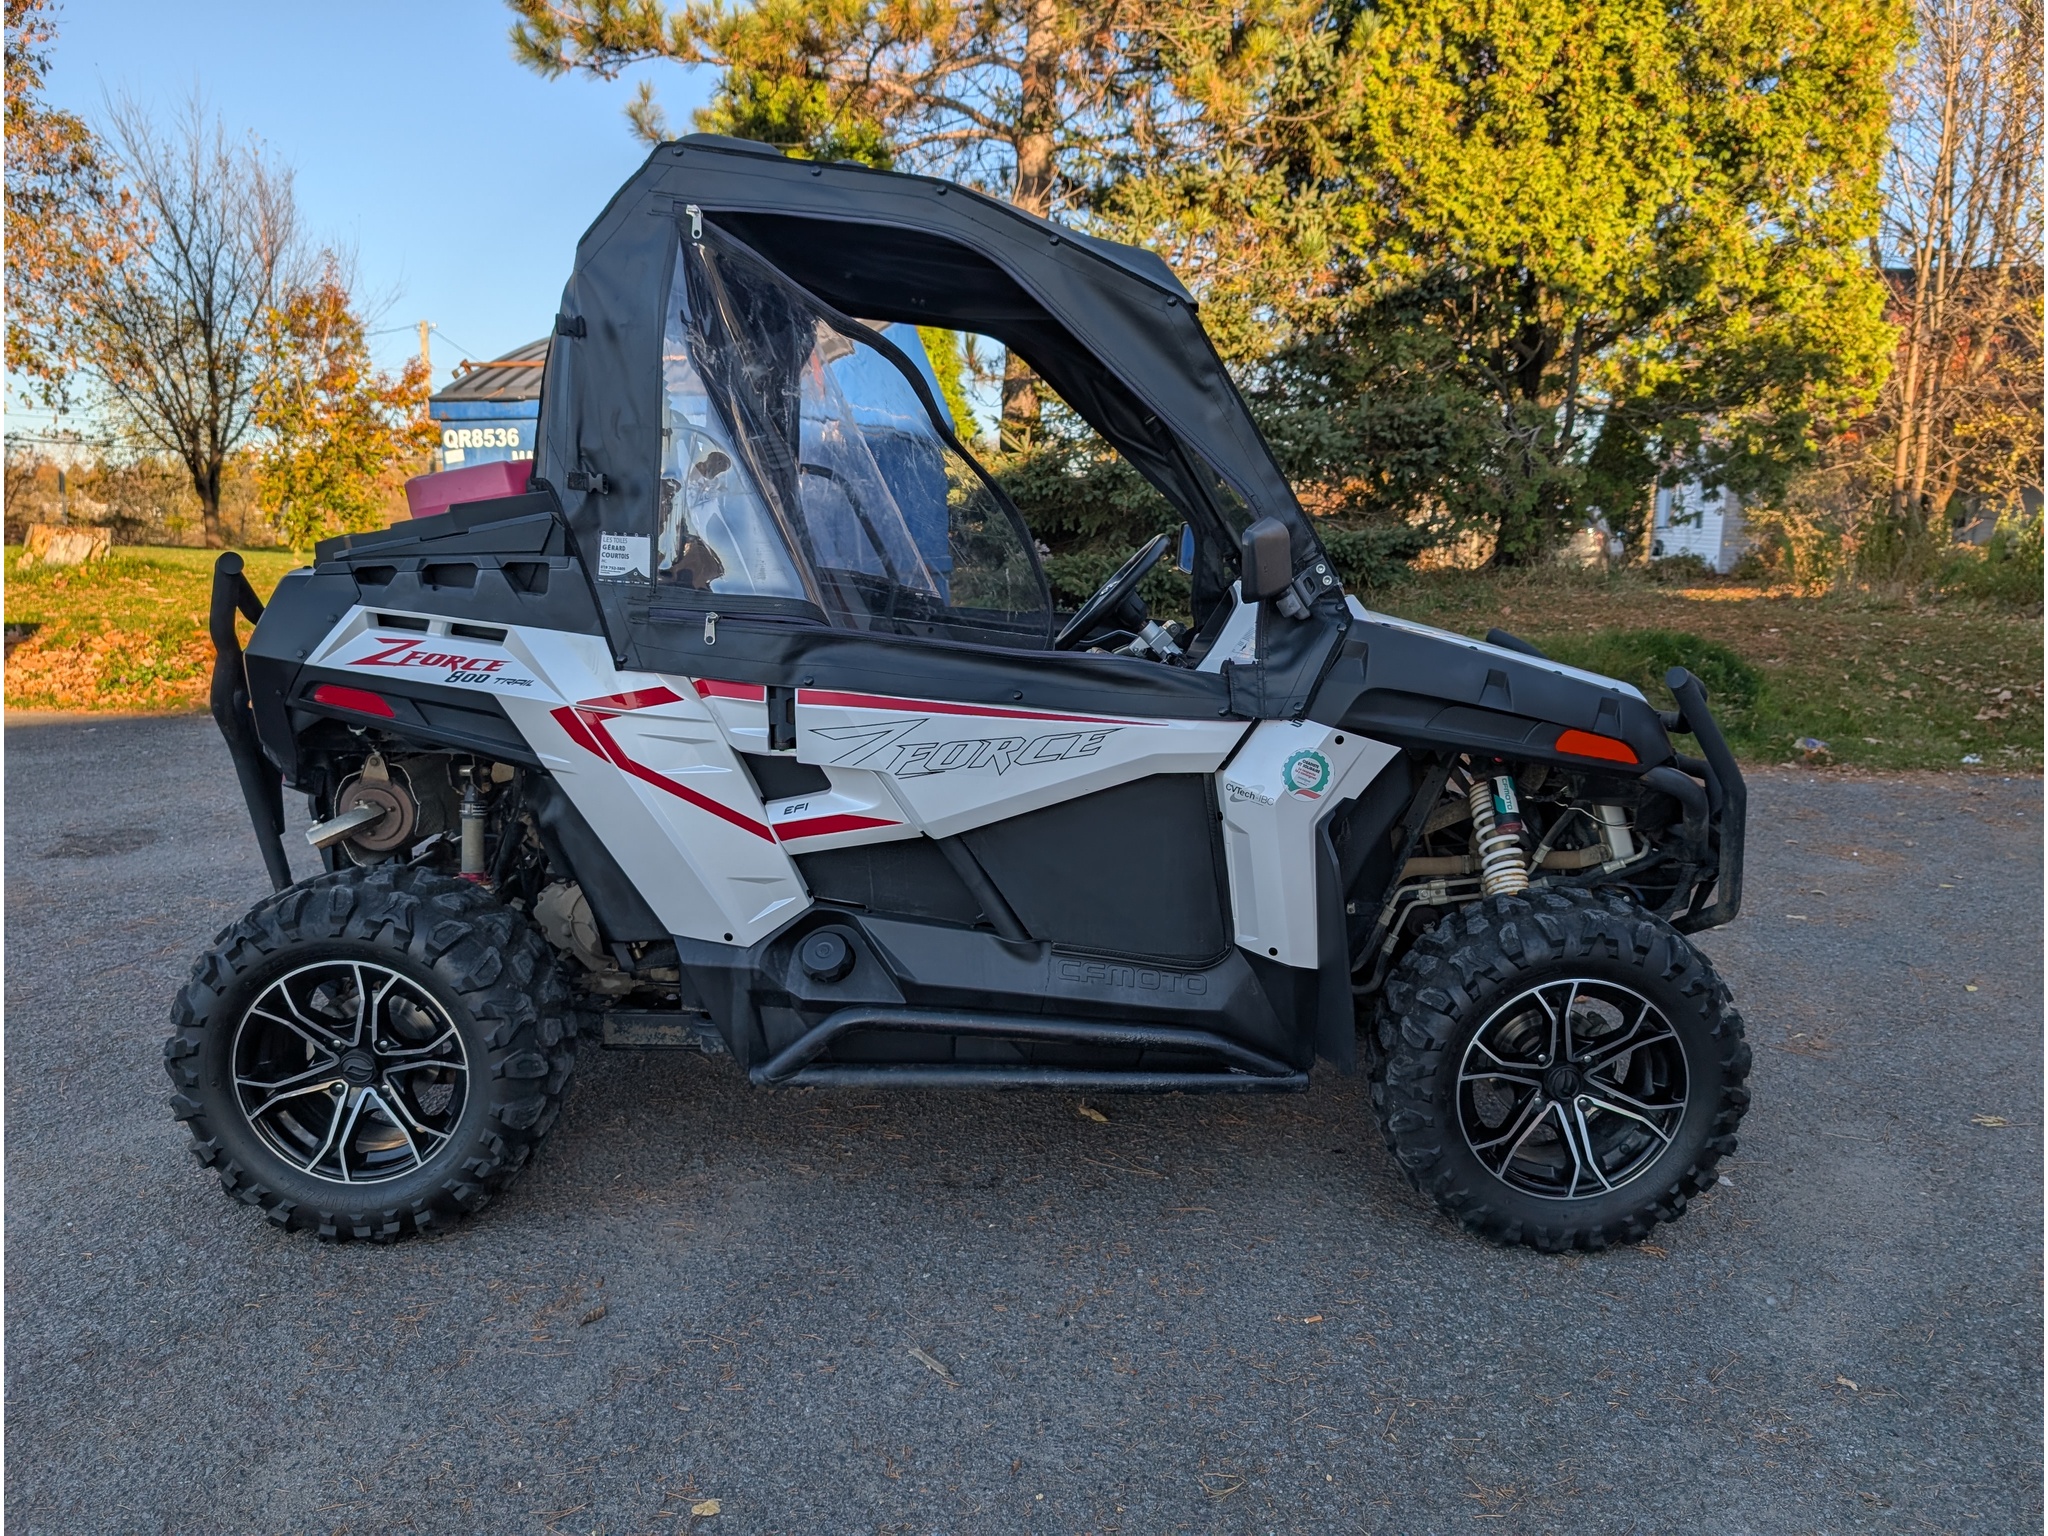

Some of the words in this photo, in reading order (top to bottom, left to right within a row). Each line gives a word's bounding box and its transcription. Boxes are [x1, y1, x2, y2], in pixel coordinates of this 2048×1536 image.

[443, 428, 520, 449] QR8536
[444, 671, 491, 683] 800
[494, 677, 535, 687] TRAIL
[1501, 777, 1513, 811] CFMOTO
[783, 802, 809, 815] EFI
[1058, 959, 1208, 996] CFMOTO
